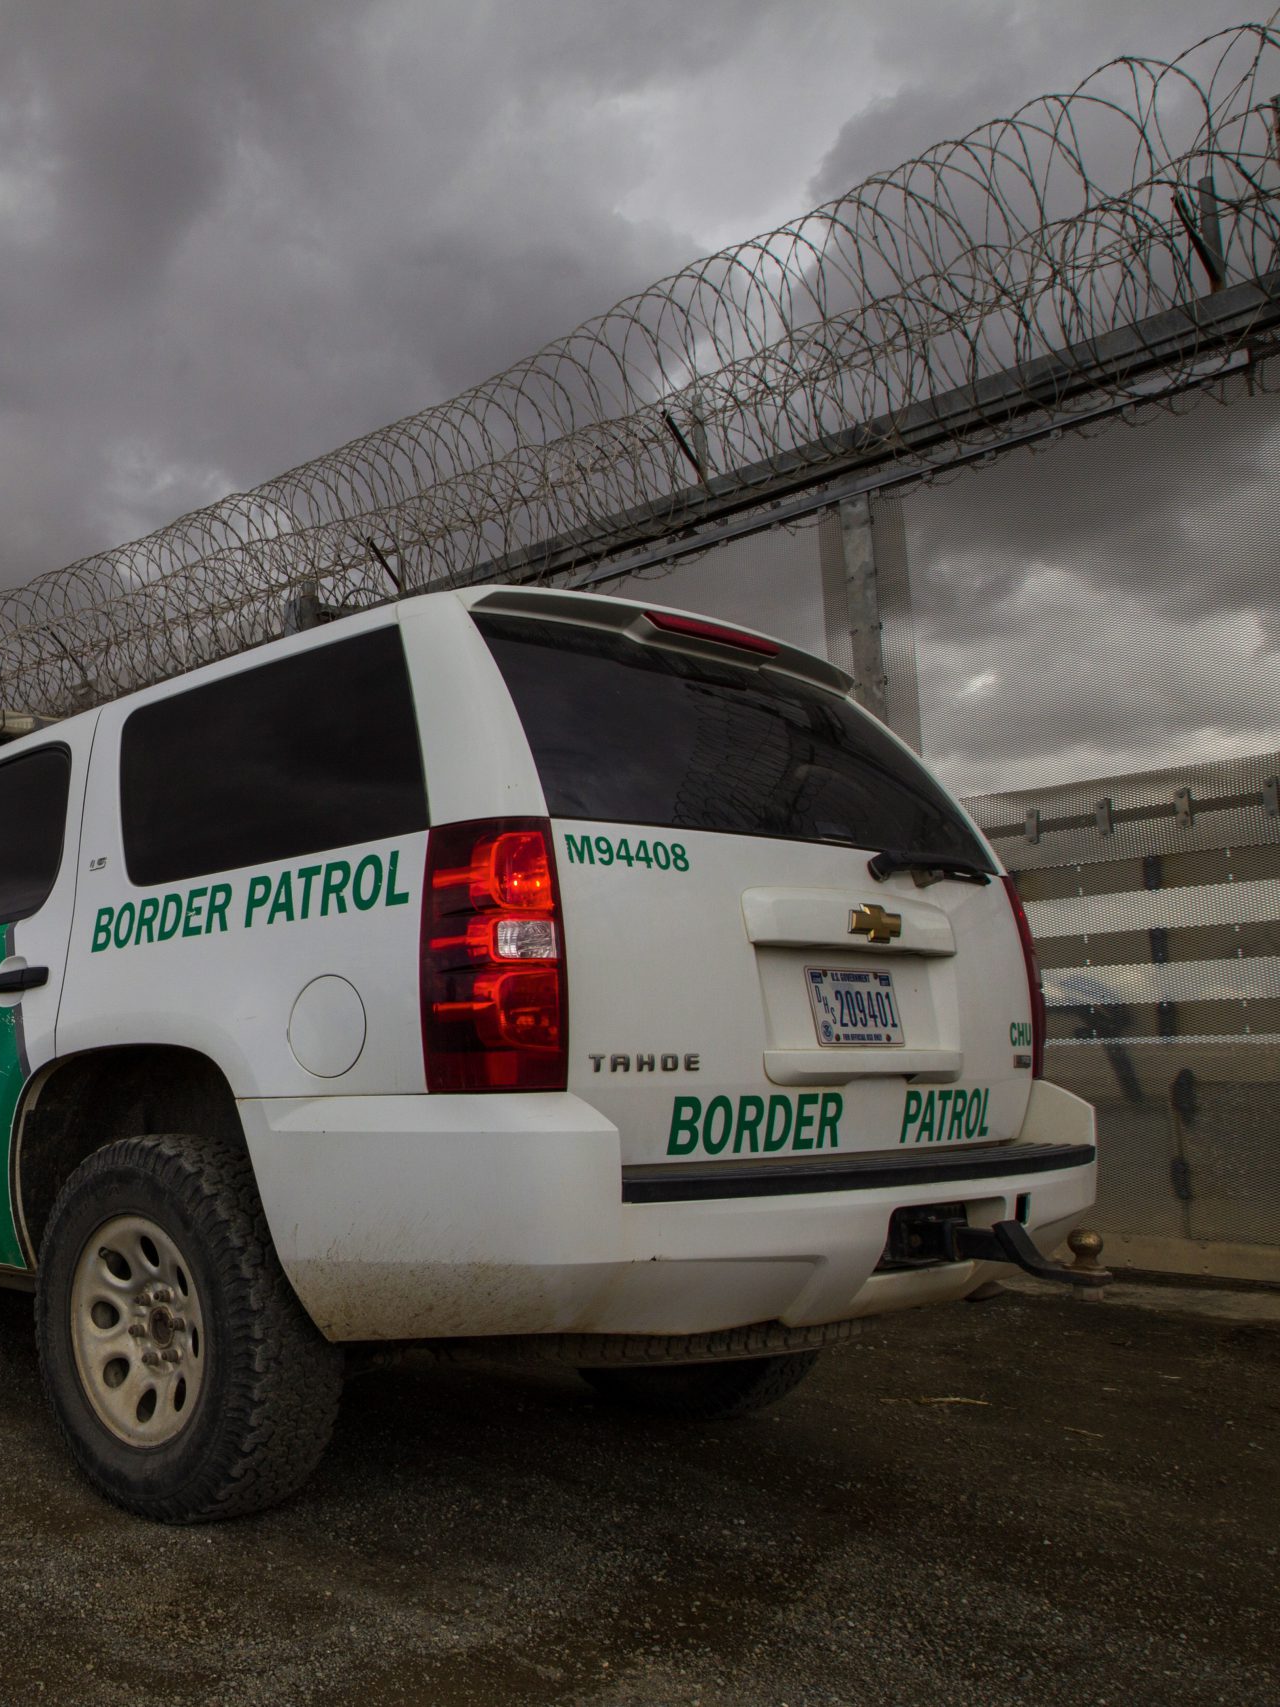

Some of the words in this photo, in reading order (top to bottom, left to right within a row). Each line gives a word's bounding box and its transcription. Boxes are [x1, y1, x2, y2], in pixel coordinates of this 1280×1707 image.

[564, 834, 690, 872] M94408
[91, 882, 233, 953] BORDER
[244, 850, 410, 928] PATROL
[834, 990, 898, 1028] 209401
[588, 1053, 700, 1073] TAHOE
[666, 1092, 843, 1156] BORDER
[899, 1087, 990, 1144] PATROL
